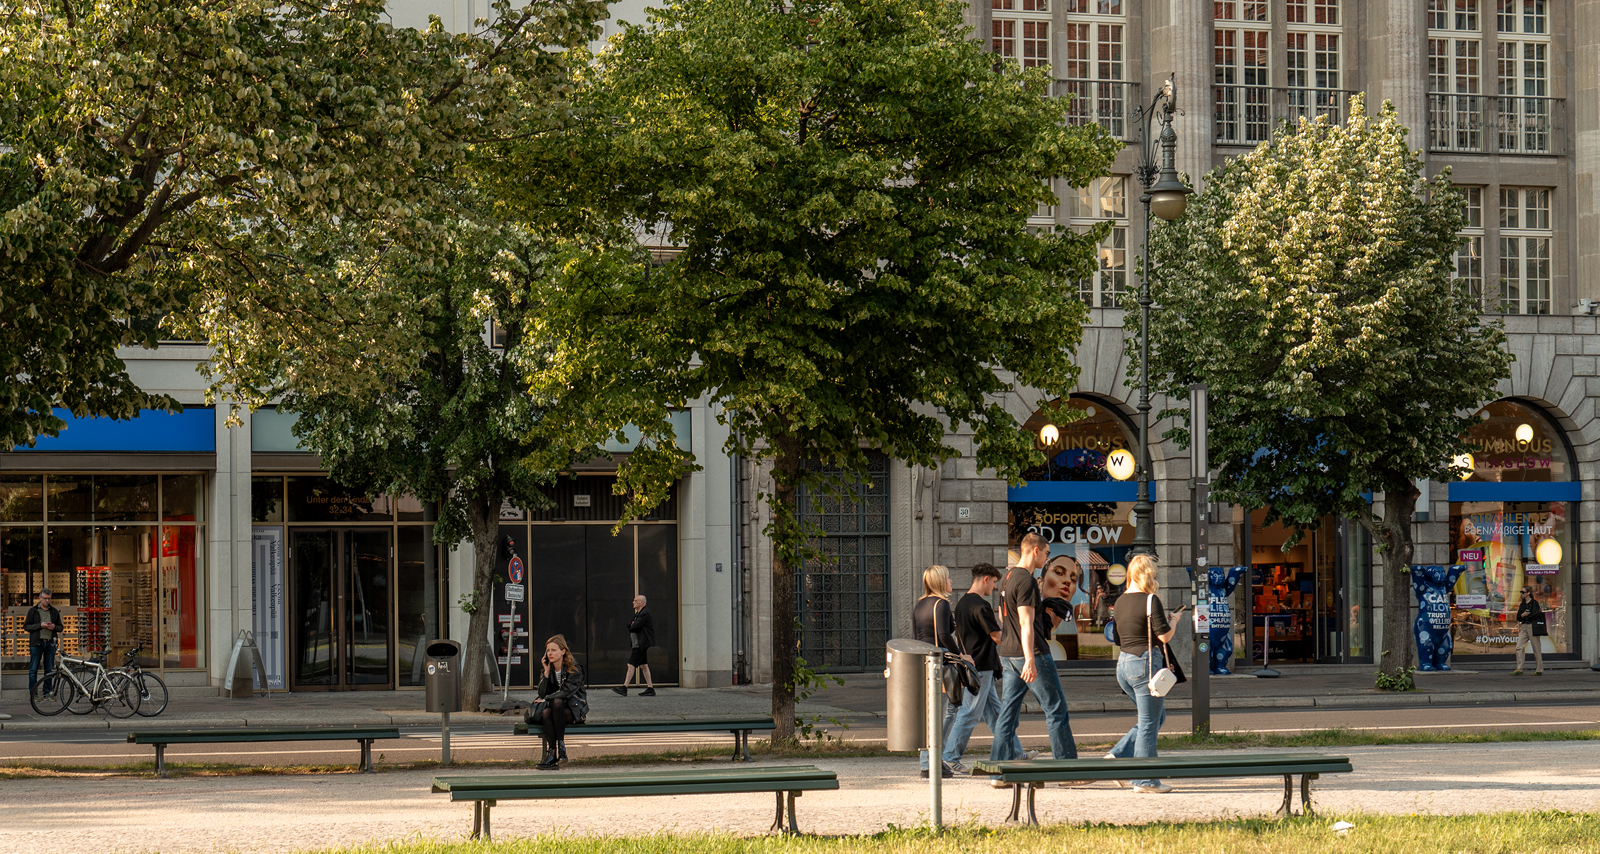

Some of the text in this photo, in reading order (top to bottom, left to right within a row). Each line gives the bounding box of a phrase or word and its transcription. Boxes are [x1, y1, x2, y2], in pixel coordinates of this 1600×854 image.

[1033, 436, 1124, 451] UMINOUS
[1050, 455, 1124, 468] INGLOW
[306, 496, 371, 504] Unter den Linde
[329, 506, 353, 514] 32-34
[960, 508, 969, 516] 30
[1035, 513, 1114, 525] SOFORTIGER
[1470, 513, 1548, 524] STRAHLENDE
[1060, 526, 1123, 544] GLOW
[1526, 525, 1553, 535] HAUT
[1463, 553, 1480, 561] NEU
